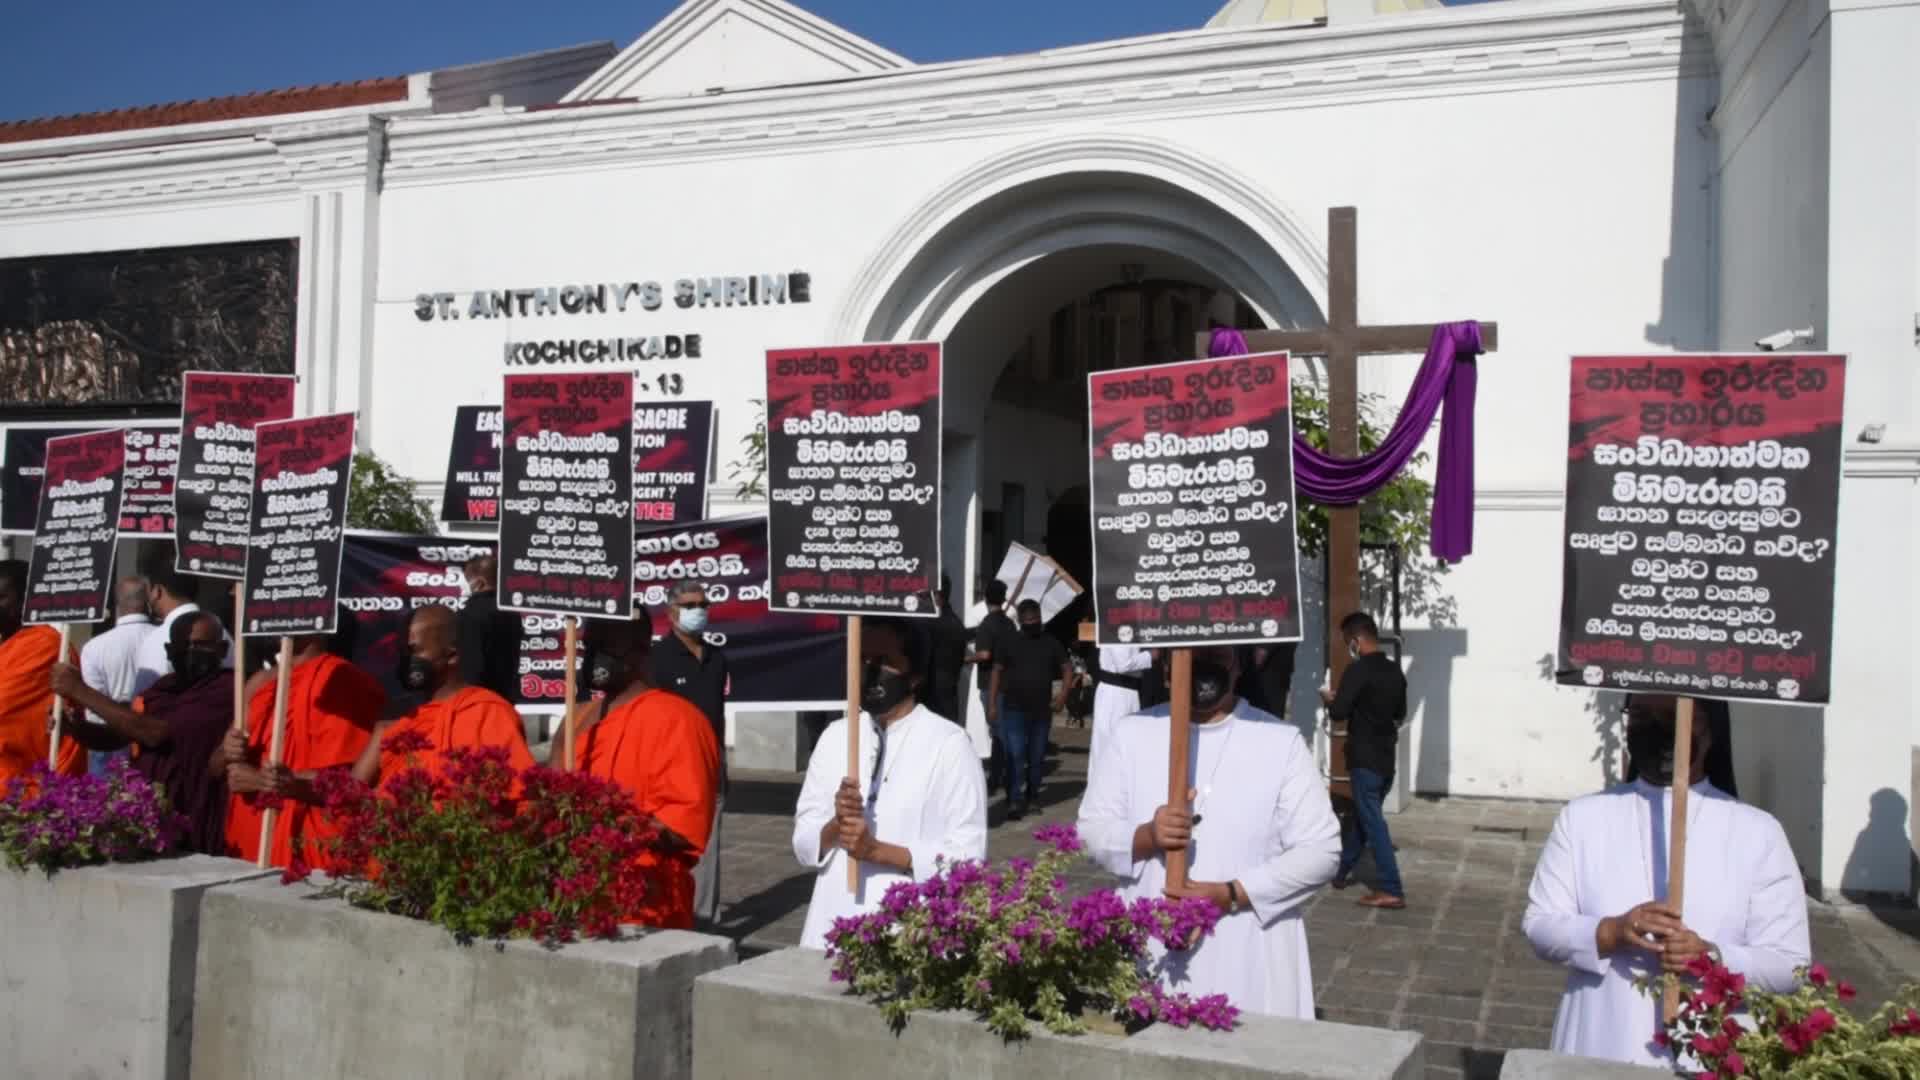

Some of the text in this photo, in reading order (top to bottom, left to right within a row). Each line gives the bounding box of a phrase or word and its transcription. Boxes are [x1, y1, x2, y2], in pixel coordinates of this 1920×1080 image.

[414, 271, 811, 321] ST. ANTHONY'S SHRINE
[503, 333, 702, 365] KOCHCHIKADE
[657, 372, 684, 396] 13
[476, 408, 688, 431] EAS SACRE
[659, 472, 695, 484] THOSE
[469, 486, 494, 497] WHO
[467, 500, 675, 520] WE TICE
[635, 532, 720, 554] හාරය
[635, 554, 750, 580] මැරුමකි.
[1716, 566, 1758, 582] සහ
